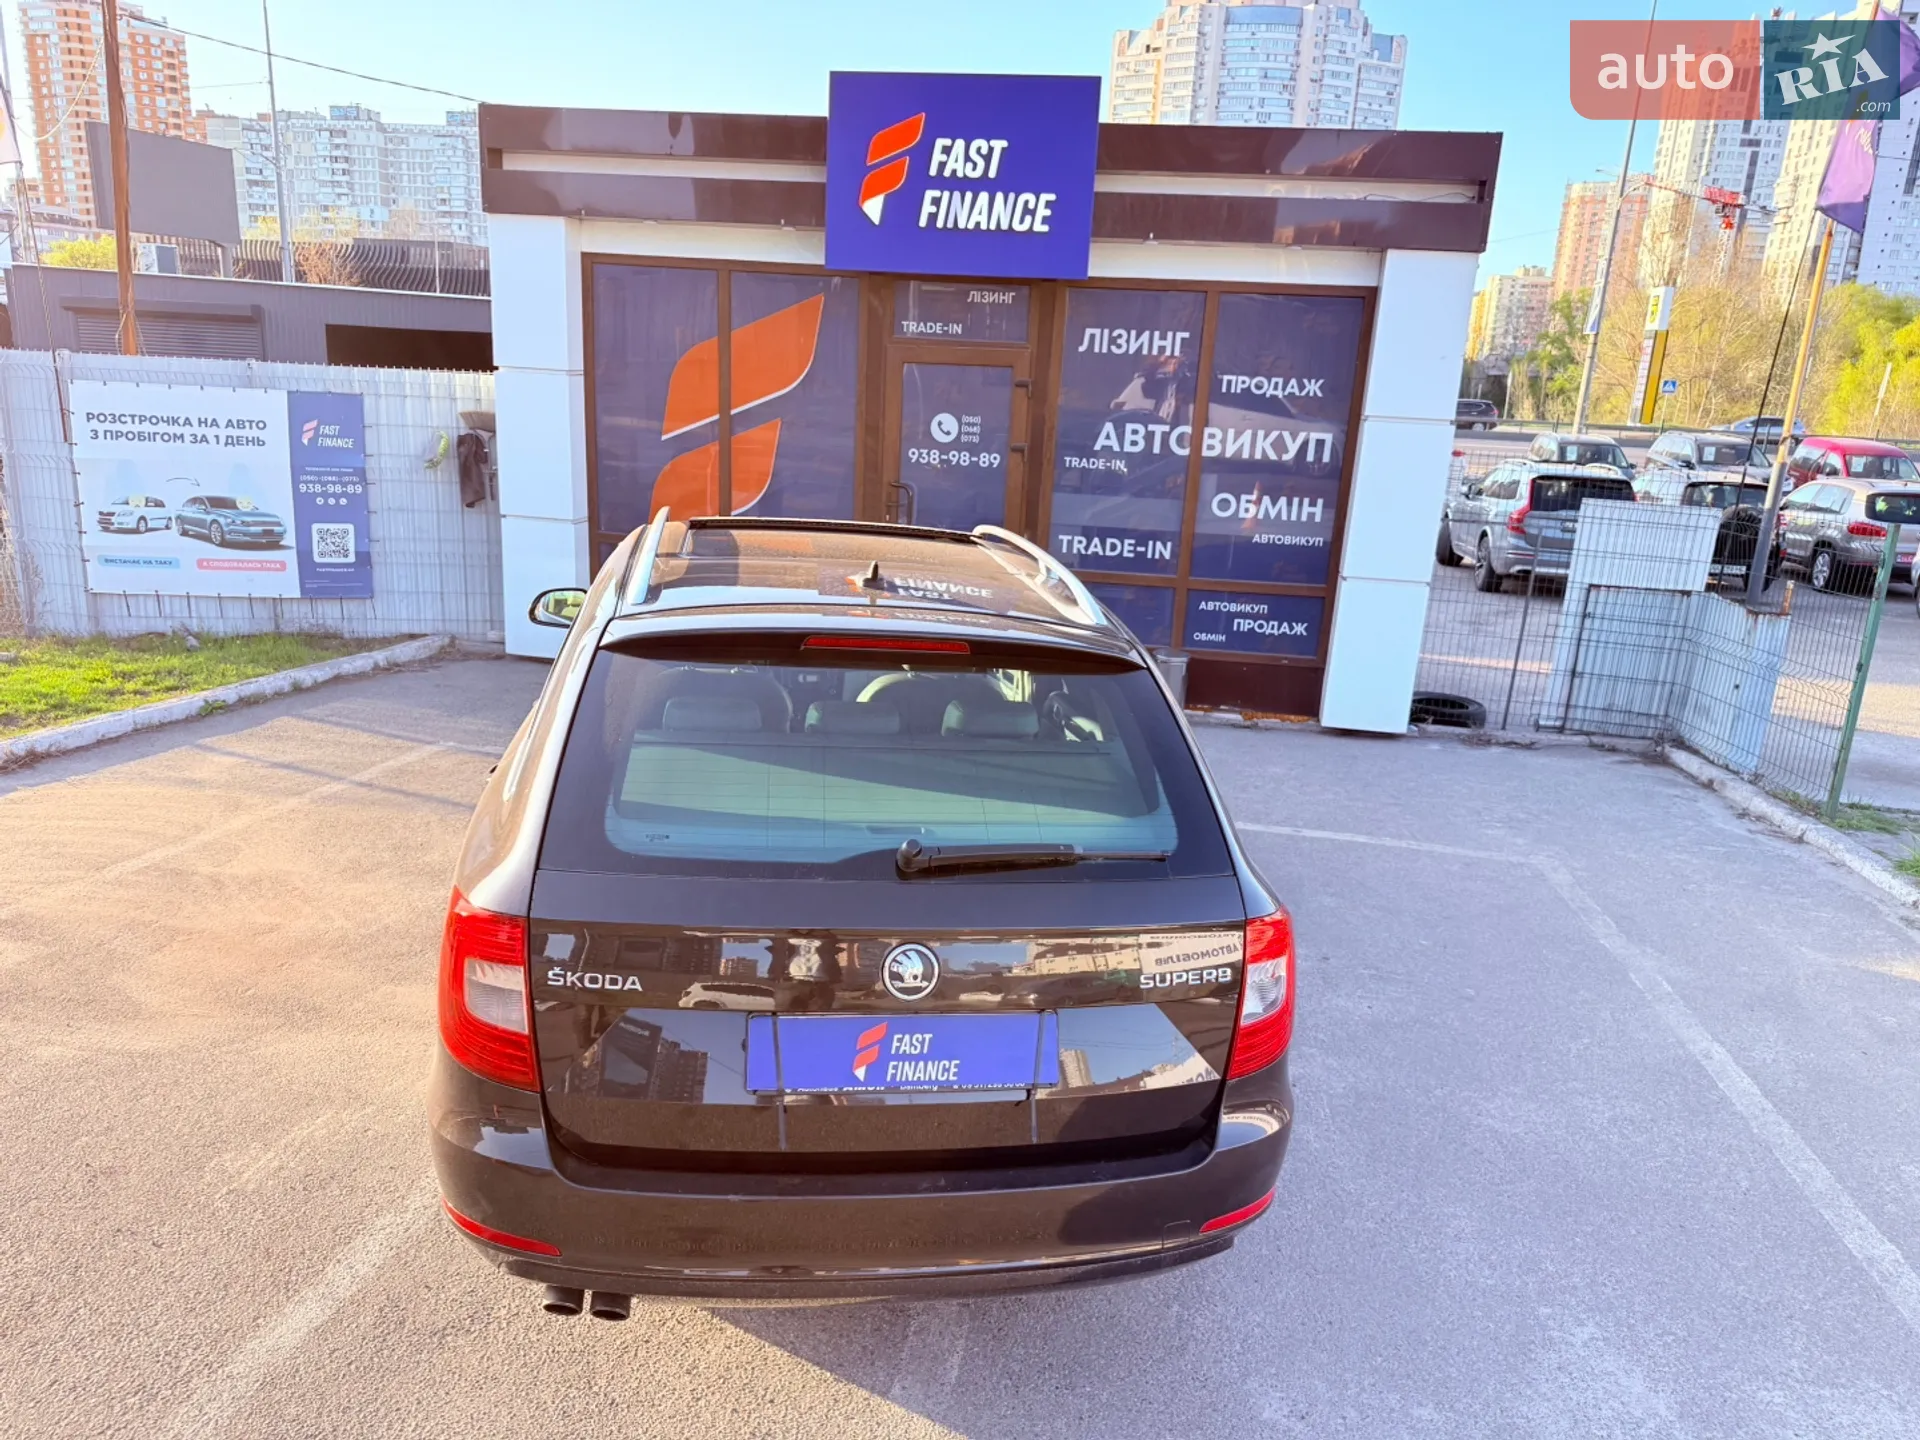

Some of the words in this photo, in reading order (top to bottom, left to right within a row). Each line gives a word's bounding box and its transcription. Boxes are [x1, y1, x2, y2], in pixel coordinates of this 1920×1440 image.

[928, 138, 1008, 178] FAST
[918, 189, 1057, 232] FINANCE
[967, 291, 1016, 305] ЛІЗИНГ
[901, 321, 963, 335] TRADE-IN
[1078, 328, 1190, 357] ЛІЗИНГ
[1221, 375, 1325, 398] ПРОДАЖ
[86, 412, 193, 428] РОЗСТРОЧКА
[198, 417, 220, 429] НА
[225, 418, 267, 431] АВТО
[319, 425, 340, 436] FAST
[104, 430, 185, 444] ПРОБІГОМ
[189, 433, 210, 445] ЗА
[213, 434, 220, 445] 1
[224, 435, 266, 448] ДЕНЬ
[317, 437, 355, 448] FINANCE
[908, 448, 1001, 468] 938-98-89
[1064, 457, 1125, 470] TRADE-IN
[299, 483, 363, 494] 938-98-89
[1211, 492, 1324, 523] ОБМІН
[1058, 535, 1172, 560] TRADE-IN
[1252, 533, 1323, 547] АВТОВИКУП
[1199, 601, 1268, 615] АВТОВИКУП
[1233, 619, 1307, 636] ПРОДАЖ
[1193, 632, 1226, 643] ОБМІН
[547, 966, 643, 992] ŠKODA
[1139, 967, 1231, 989] SUPERB
[890, 1033, 933, 1055] FAST
[886, 1060, 960, 1081] FINANCE
